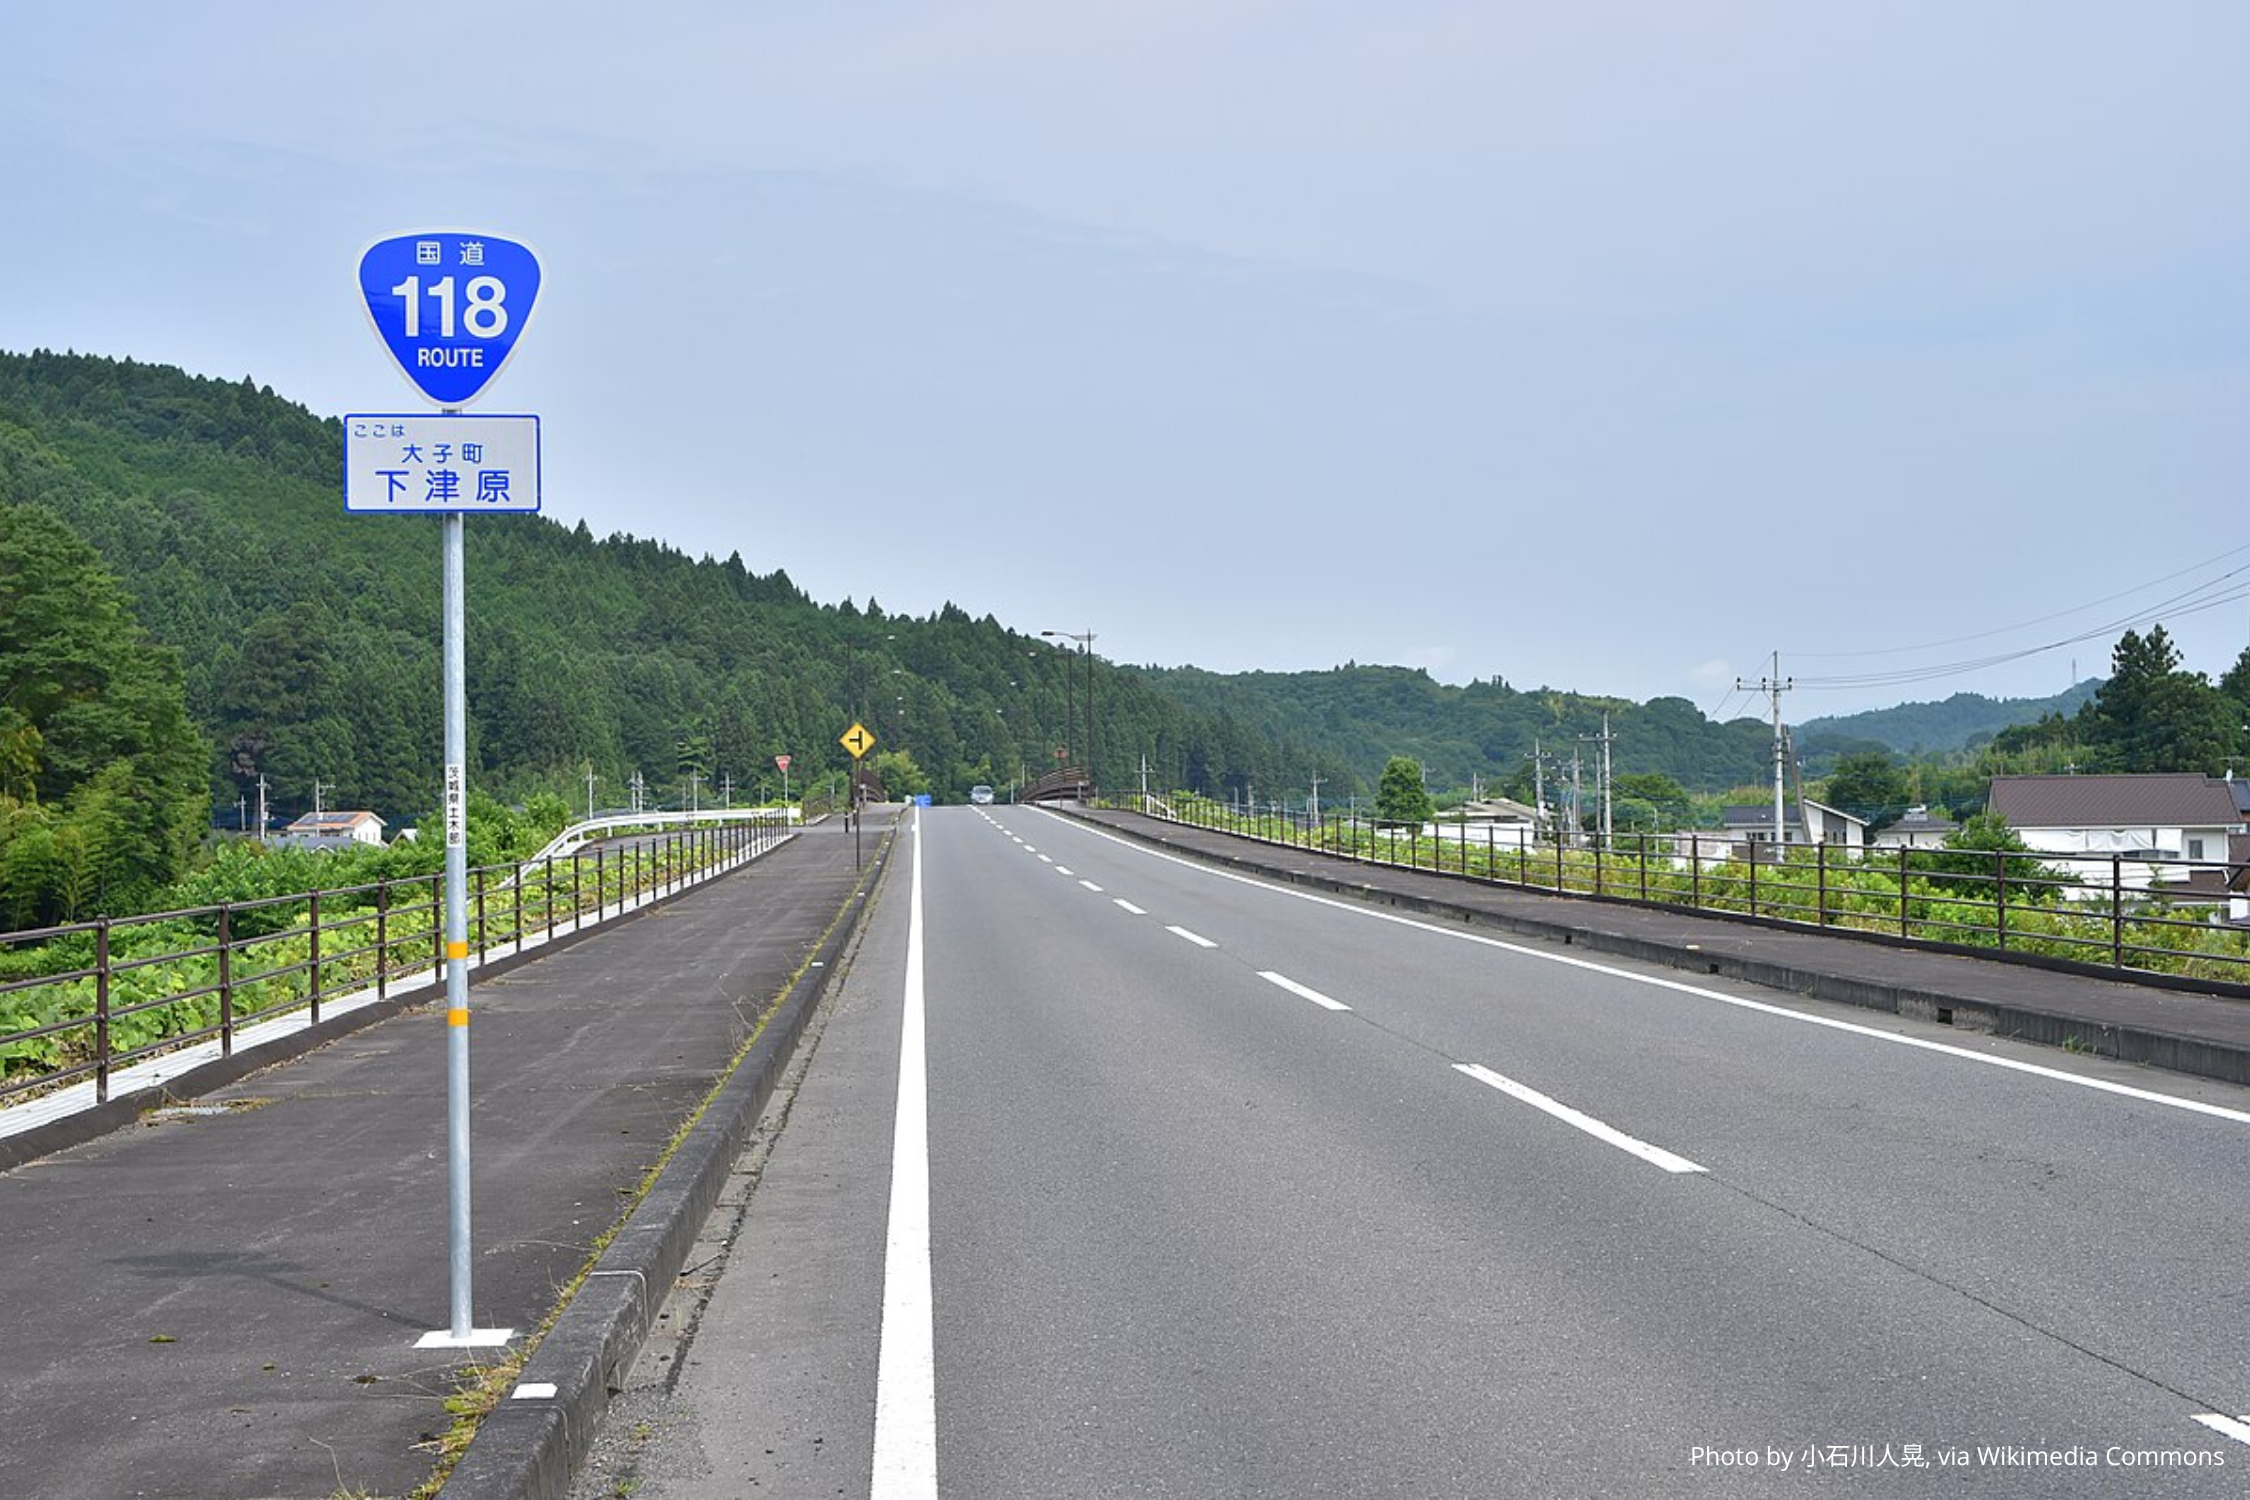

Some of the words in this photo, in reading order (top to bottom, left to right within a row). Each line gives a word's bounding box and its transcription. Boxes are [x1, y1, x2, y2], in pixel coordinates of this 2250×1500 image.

[416, 241, 485, 266] 国道
[391, 275, 508, 339] 118
[417, 348, 484, 367] ROUTE
[354, 424, 405, 438] ここは
[401, 443, 484, 464] 大子町
[375, 469, 511, 502] 下津原
